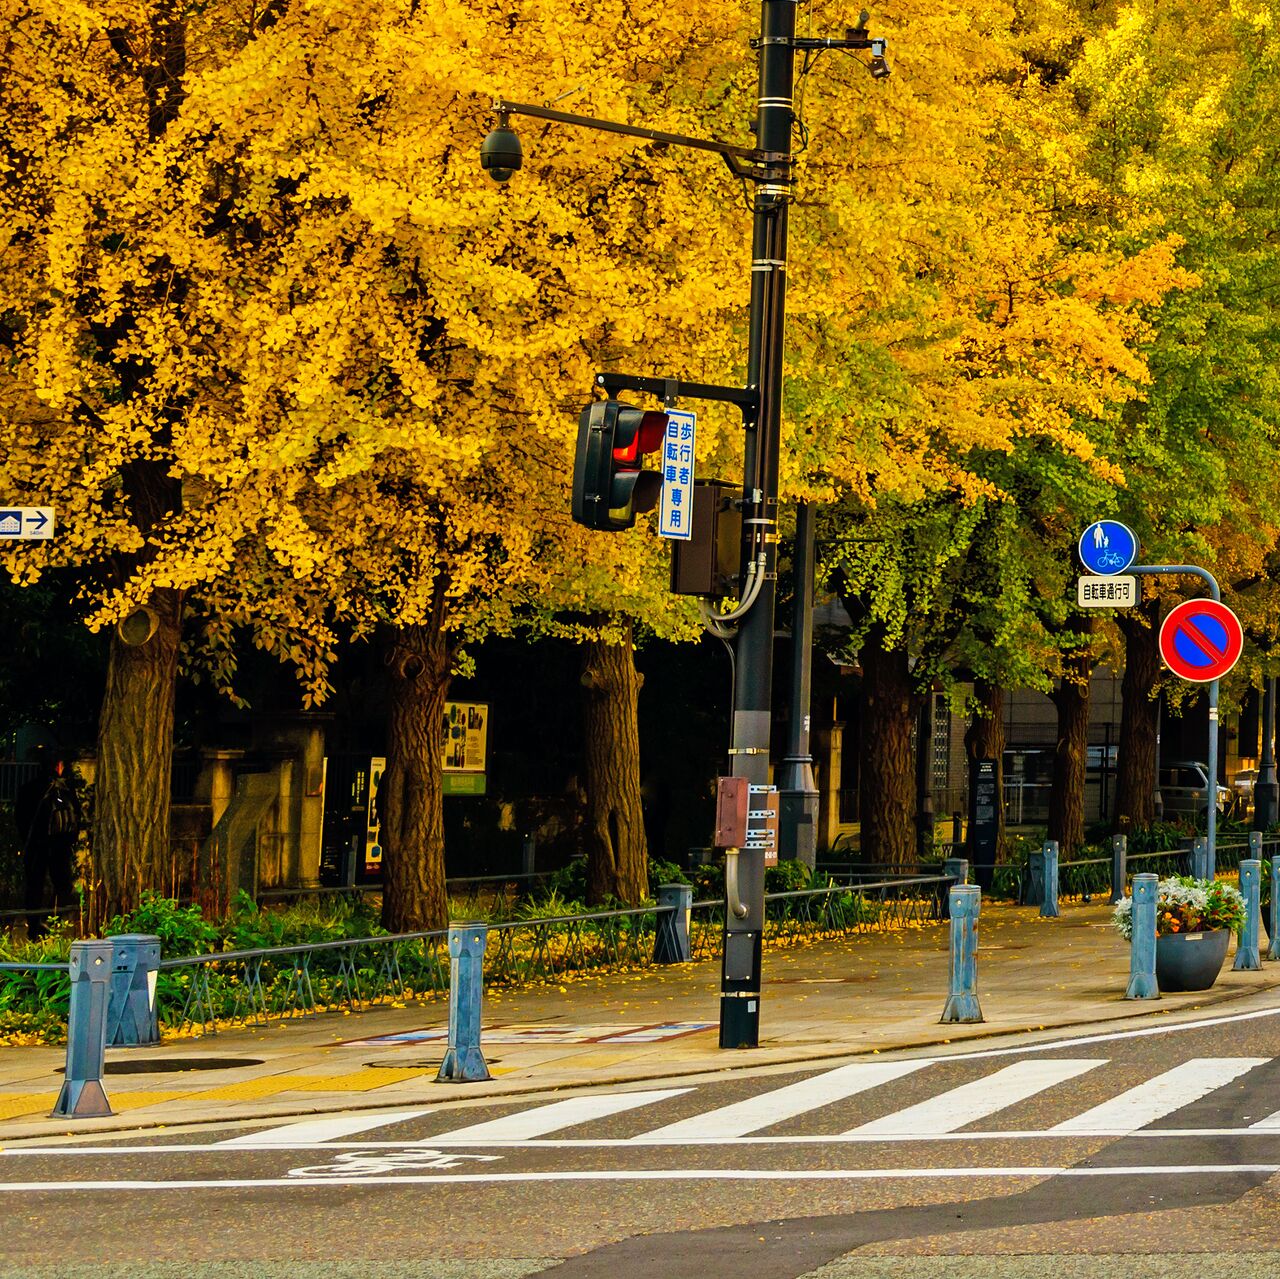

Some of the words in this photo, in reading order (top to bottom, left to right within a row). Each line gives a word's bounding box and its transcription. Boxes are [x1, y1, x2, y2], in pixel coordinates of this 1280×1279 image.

[666, 420, 679, 483] 自転車
[679, 422, 692, 485] 歩行者
[670, 488, 682, 528] 専用
[1083, 582, 1130, 600] 自転車通行可
